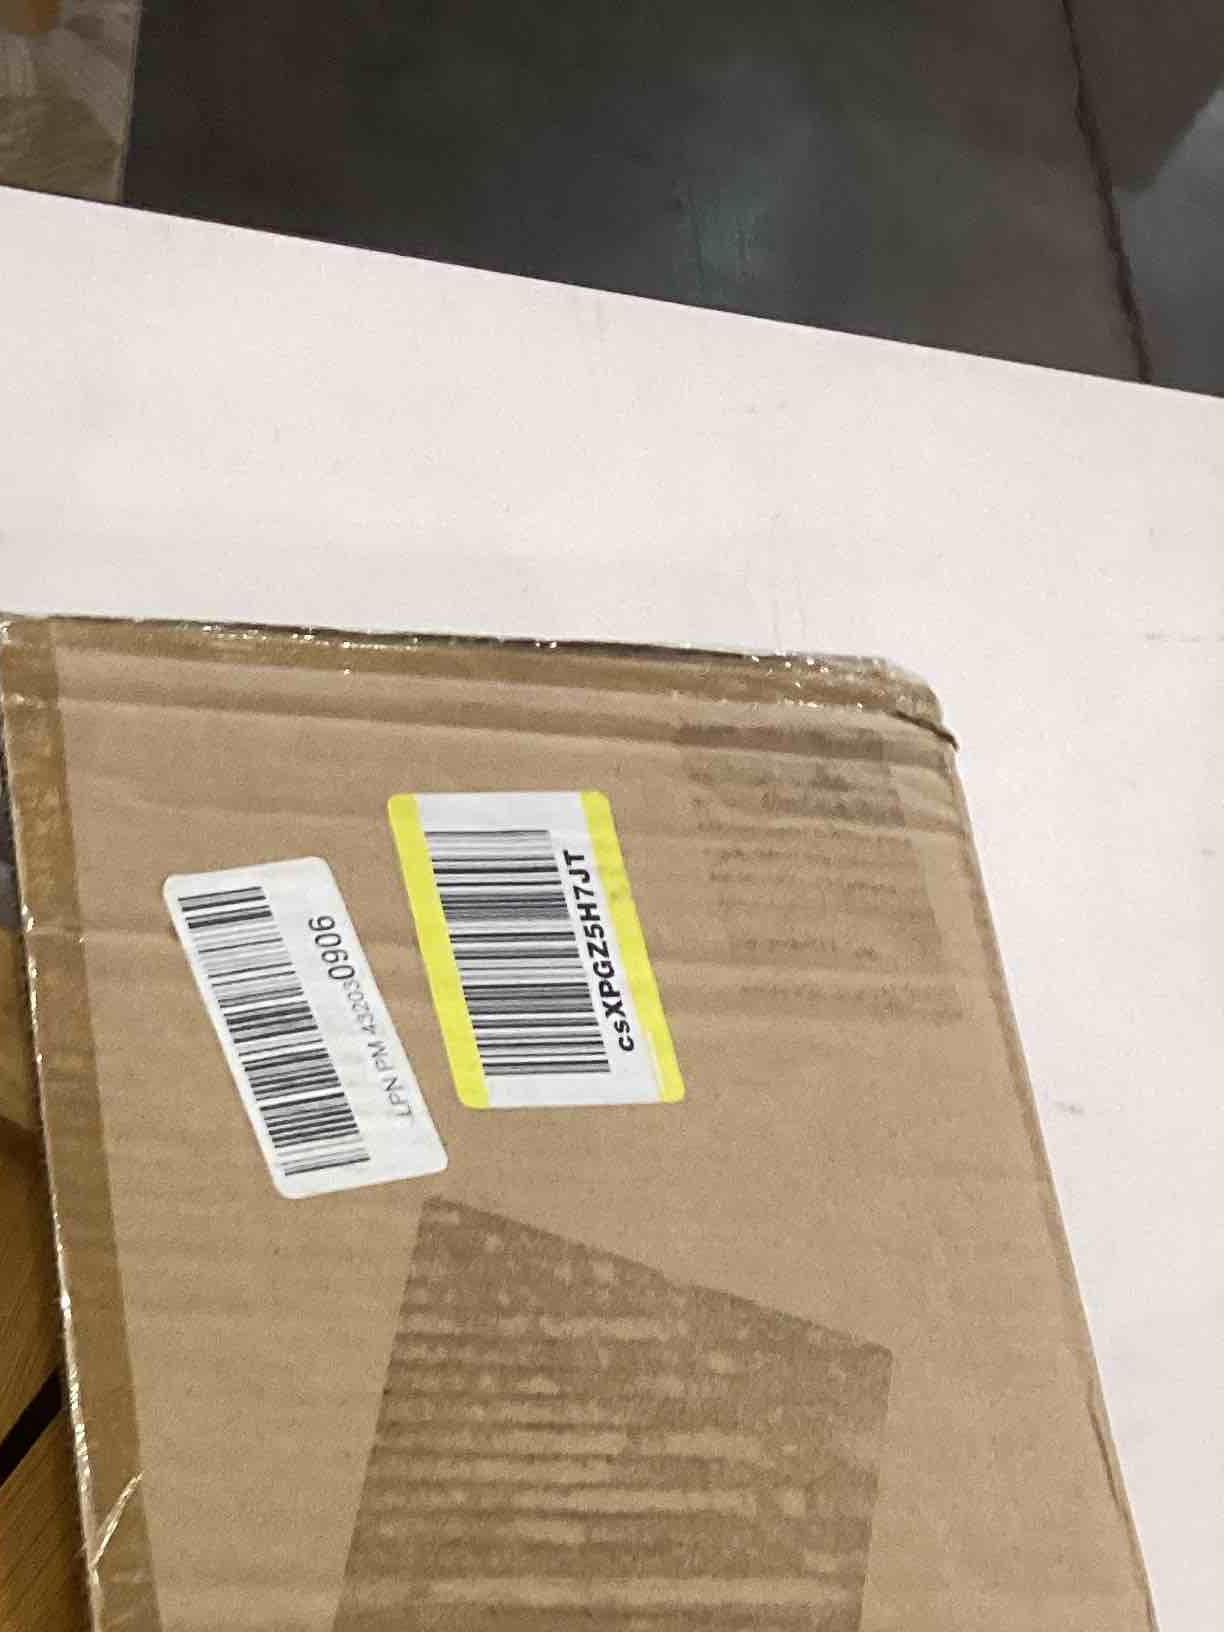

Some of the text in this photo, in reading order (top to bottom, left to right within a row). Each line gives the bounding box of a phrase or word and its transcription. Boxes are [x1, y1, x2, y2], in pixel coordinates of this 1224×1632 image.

[563, 850, 635, 1053] csXPGZ5H7JT
[367, 1040, 395, 1072] PM
[378, 1076, 412, 1118] LPN
